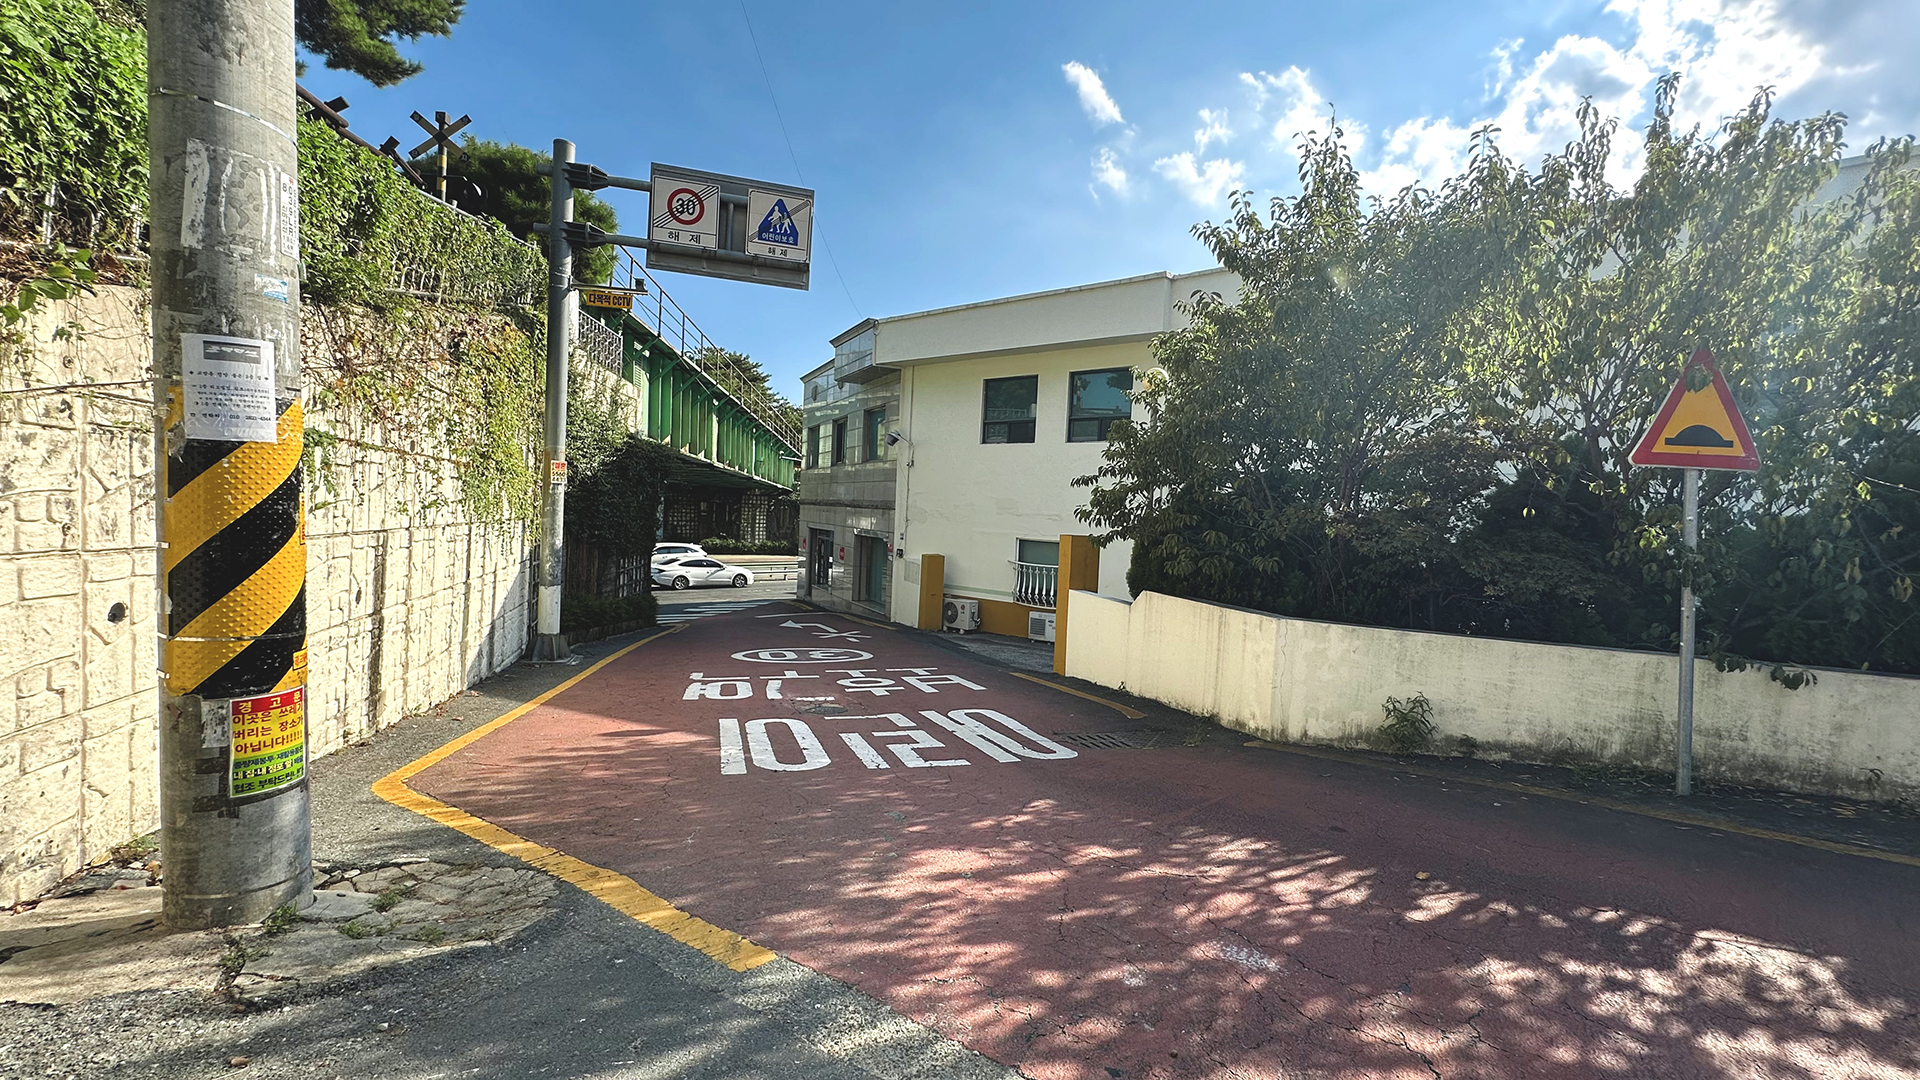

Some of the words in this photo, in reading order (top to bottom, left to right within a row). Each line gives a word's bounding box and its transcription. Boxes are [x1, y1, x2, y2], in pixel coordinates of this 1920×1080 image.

[676, 197, 696, 216] 30
[761, 231, 795, 244] 어린이보호
[589, 293, 611, 305] 다목적
[612, 295, 631, 307] CCTV
[758, 650, 850, 661] 30
[682, 667, 987, 702] 보호구역
[232, 711, 272, 726] 이곳은
[278, 702, 303, 718] 쓰레기
[232, 726, 273, 740] 버리는
[278, 715, 304, 732] 장소가
[718, 708, 1079, 776] 어린이
[233, 781, 255, 794] 협조
